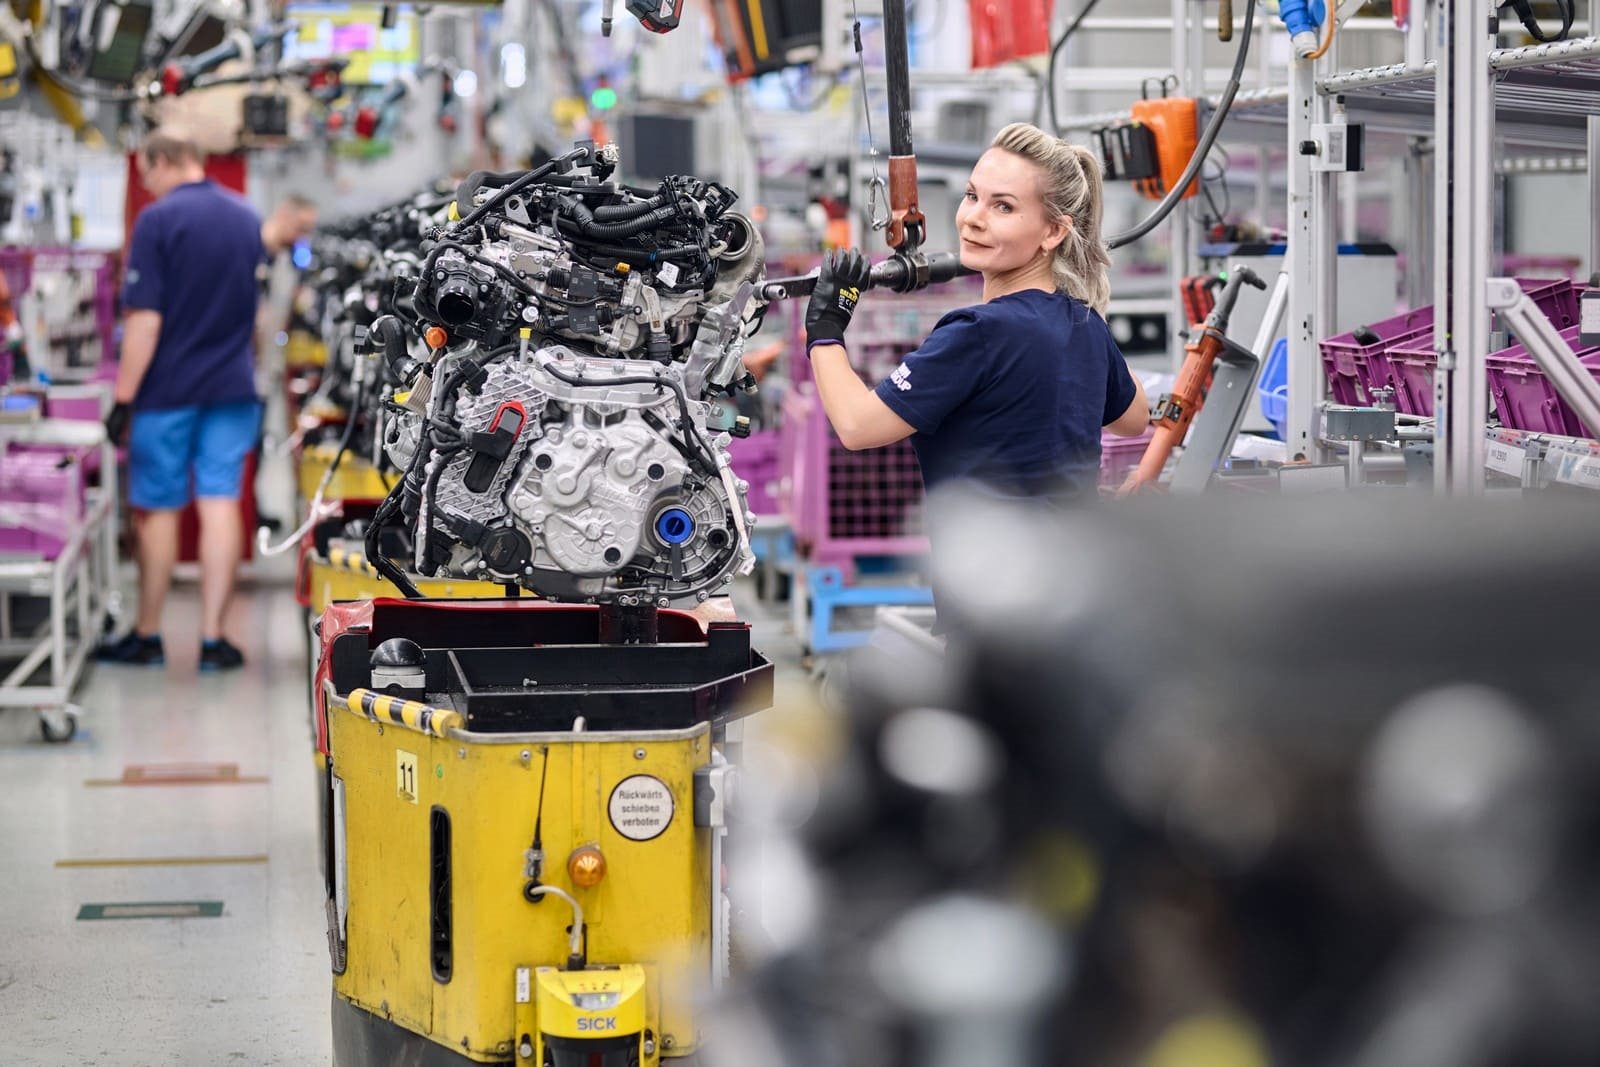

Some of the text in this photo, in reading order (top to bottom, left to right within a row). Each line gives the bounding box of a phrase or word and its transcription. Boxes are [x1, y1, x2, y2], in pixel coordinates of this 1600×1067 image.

[400, 761, 414, 793] 11
[621, 804, 660, 813] schieben
[622, 817, 660, 827] verboten
[576, 1017, 617, 1031] SICK
